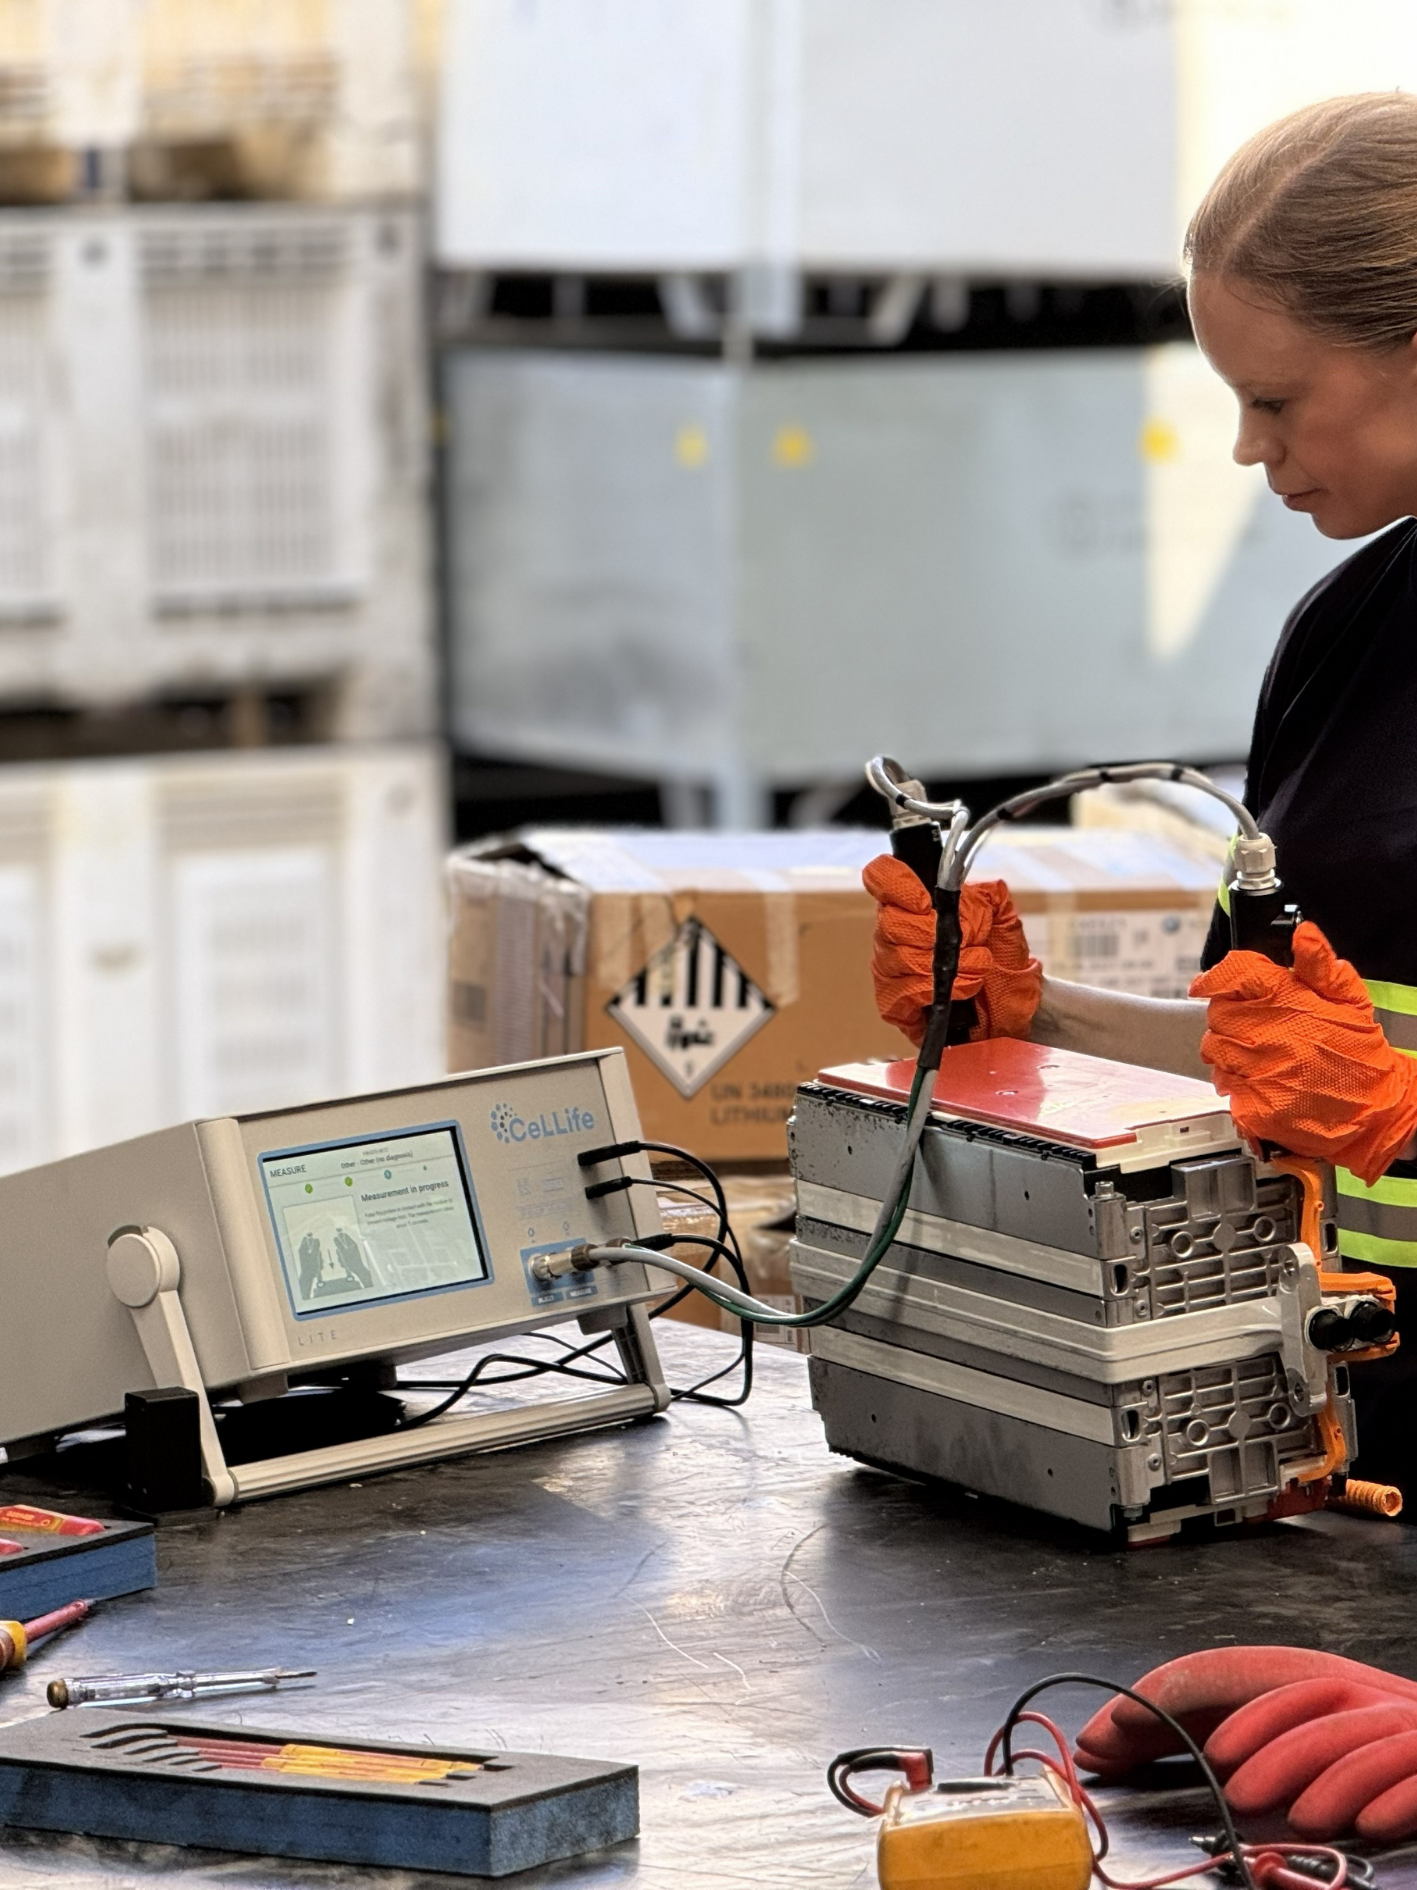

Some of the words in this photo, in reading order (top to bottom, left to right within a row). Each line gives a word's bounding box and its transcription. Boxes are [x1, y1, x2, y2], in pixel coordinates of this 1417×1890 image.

[270, 1164, 307, 1178] MEASURE
[361, 1187, 410, 1202] Measurement
[410, 1185, 418, 1194] in
[418, 1180, 450, 1194] progress
[298, 1329, 337, 1346] LITE
